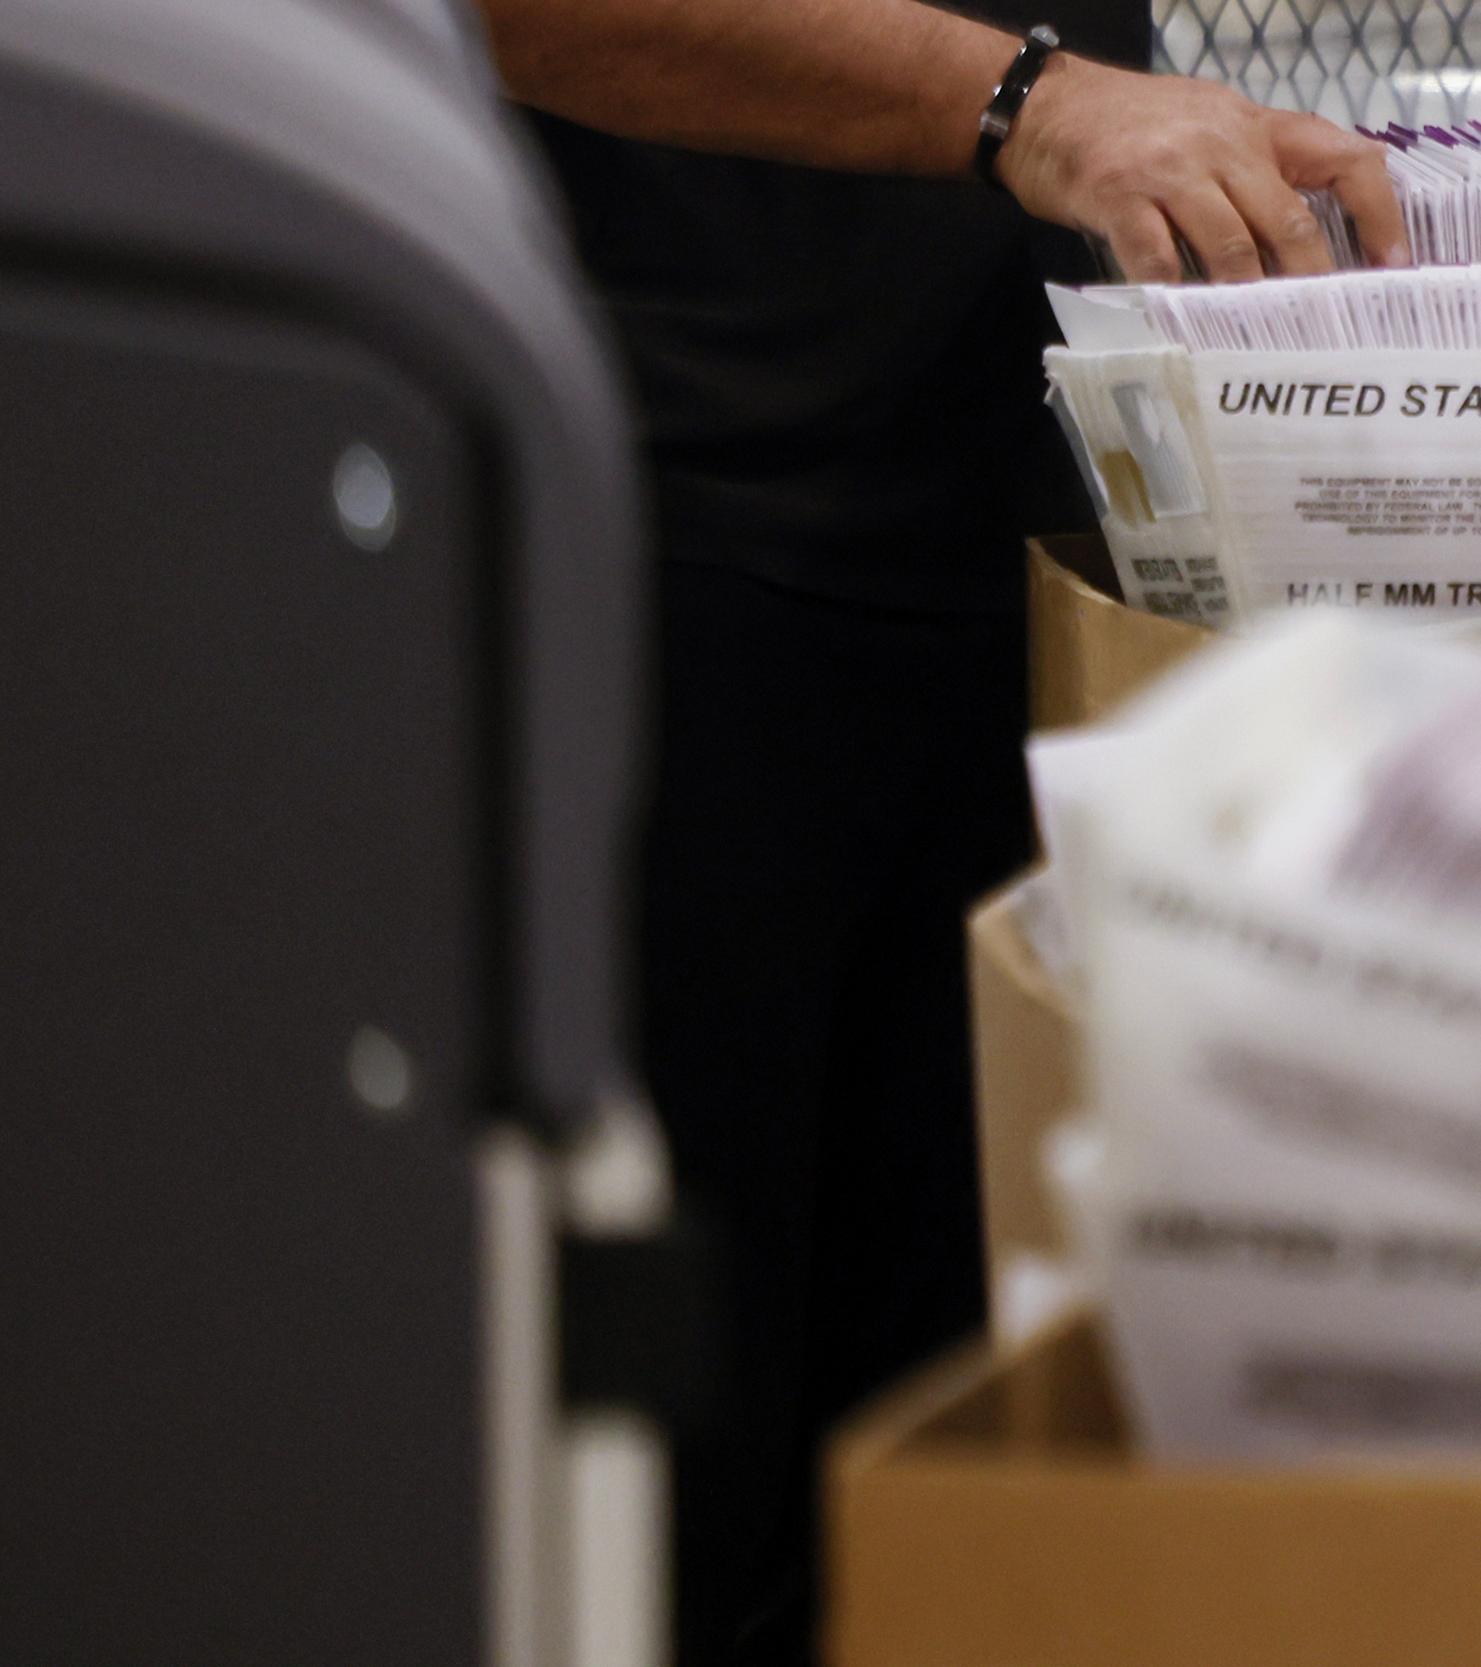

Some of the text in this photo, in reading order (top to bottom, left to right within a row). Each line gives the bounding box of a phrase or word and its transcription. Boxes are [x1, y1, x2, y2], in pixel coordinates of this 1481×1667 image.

[1218, 381, 1385, 417] UNITED
[1286, 583, 1373, 607] HALF
[1383, 583, 1436, 608] MM
